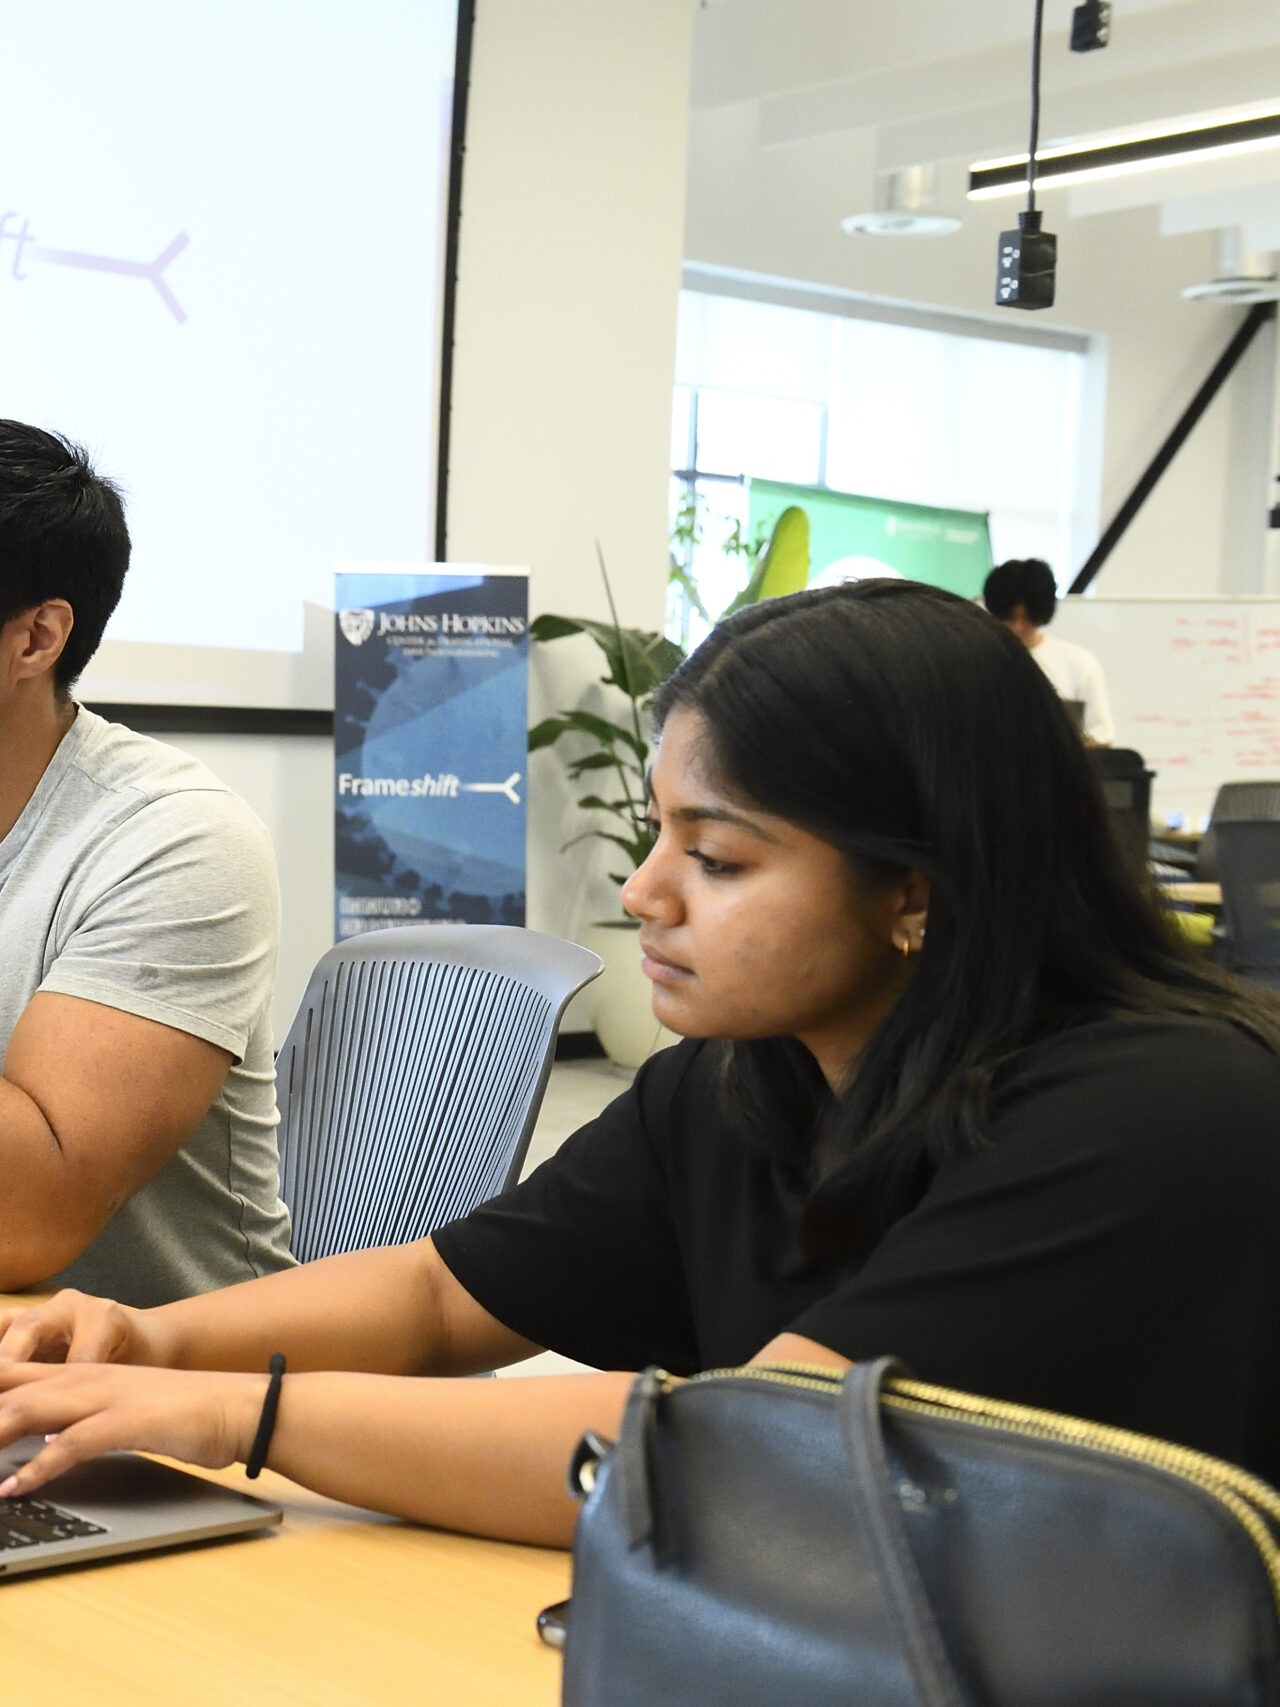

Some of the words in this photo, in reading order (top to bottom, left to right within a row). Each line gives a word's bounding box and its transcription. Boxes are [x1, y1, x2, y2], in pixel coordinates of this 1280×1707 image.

[377, 611, 439, 636] JOHNS
[442, 613, 526, 634] HOPKINS
[338, 772, 460, 798] Frameshift
